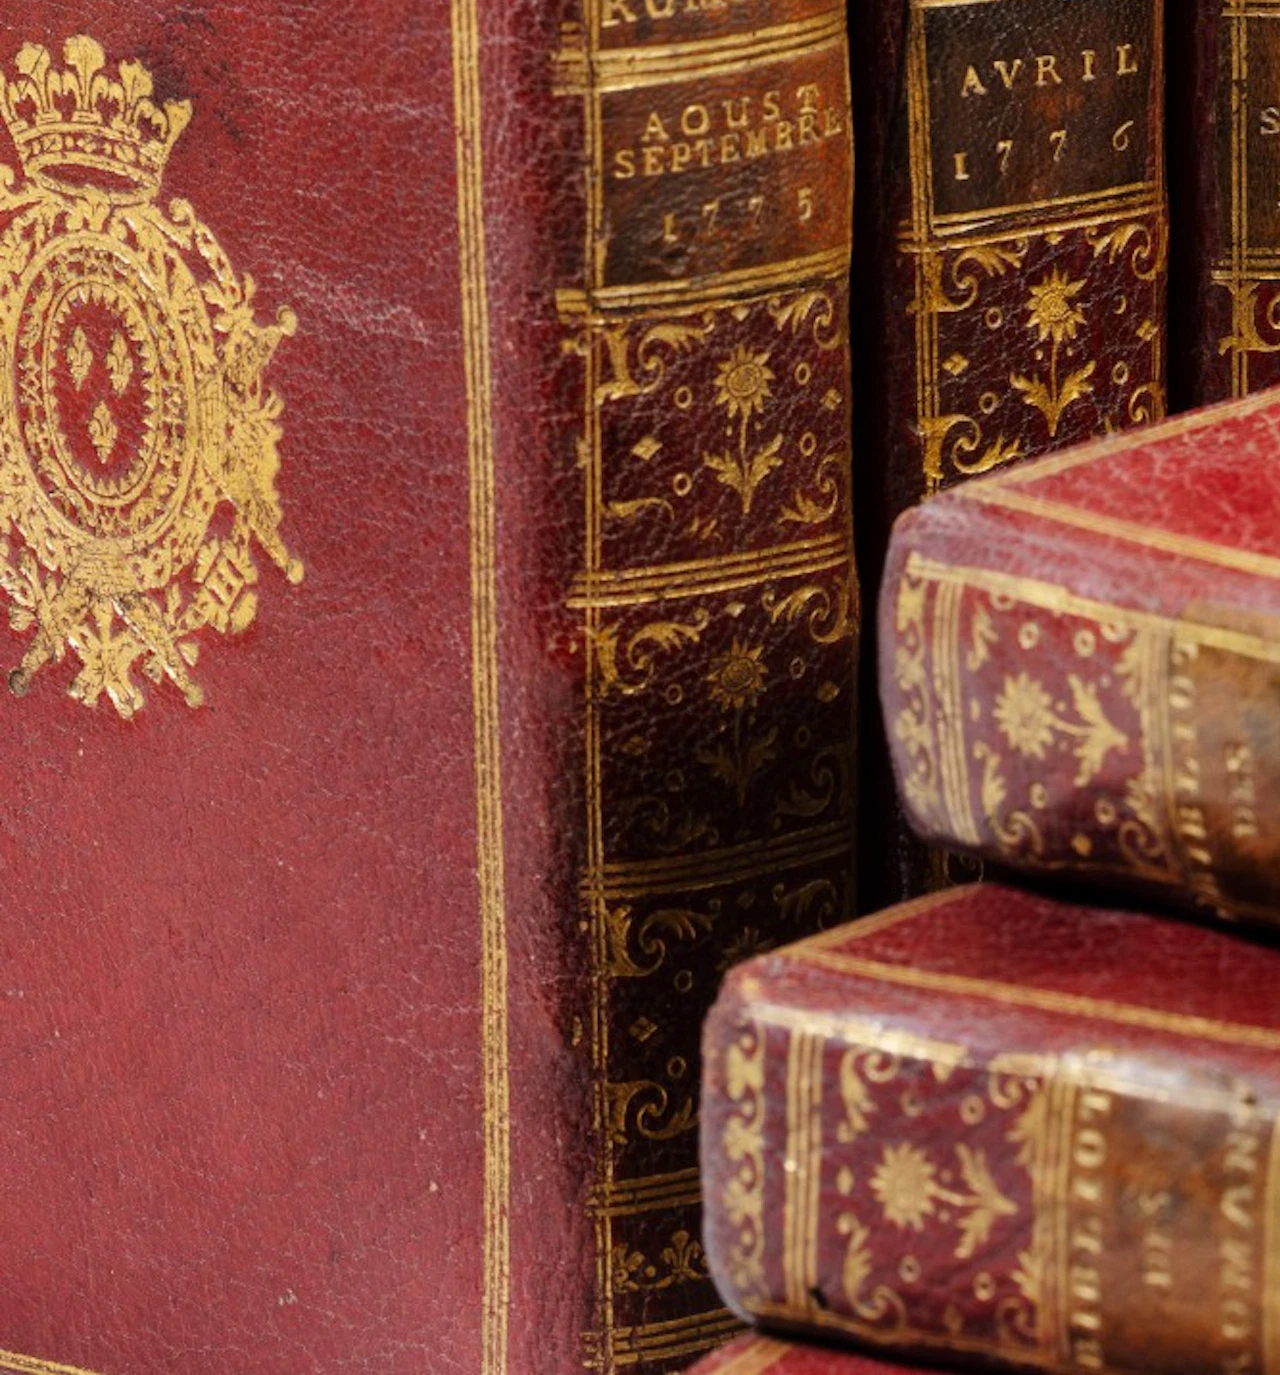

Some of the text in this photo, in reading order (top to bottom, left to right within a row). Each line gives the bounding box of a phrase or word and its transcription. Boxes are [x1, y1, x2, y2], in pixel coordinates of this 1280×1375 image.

[960, 43, 1138, 97] AVRIL
[641, 83, 819, 143] AOUST
[614, 108, 843, 179] SEPTEMBRE
[953, 120, 1134, 181] 1776
